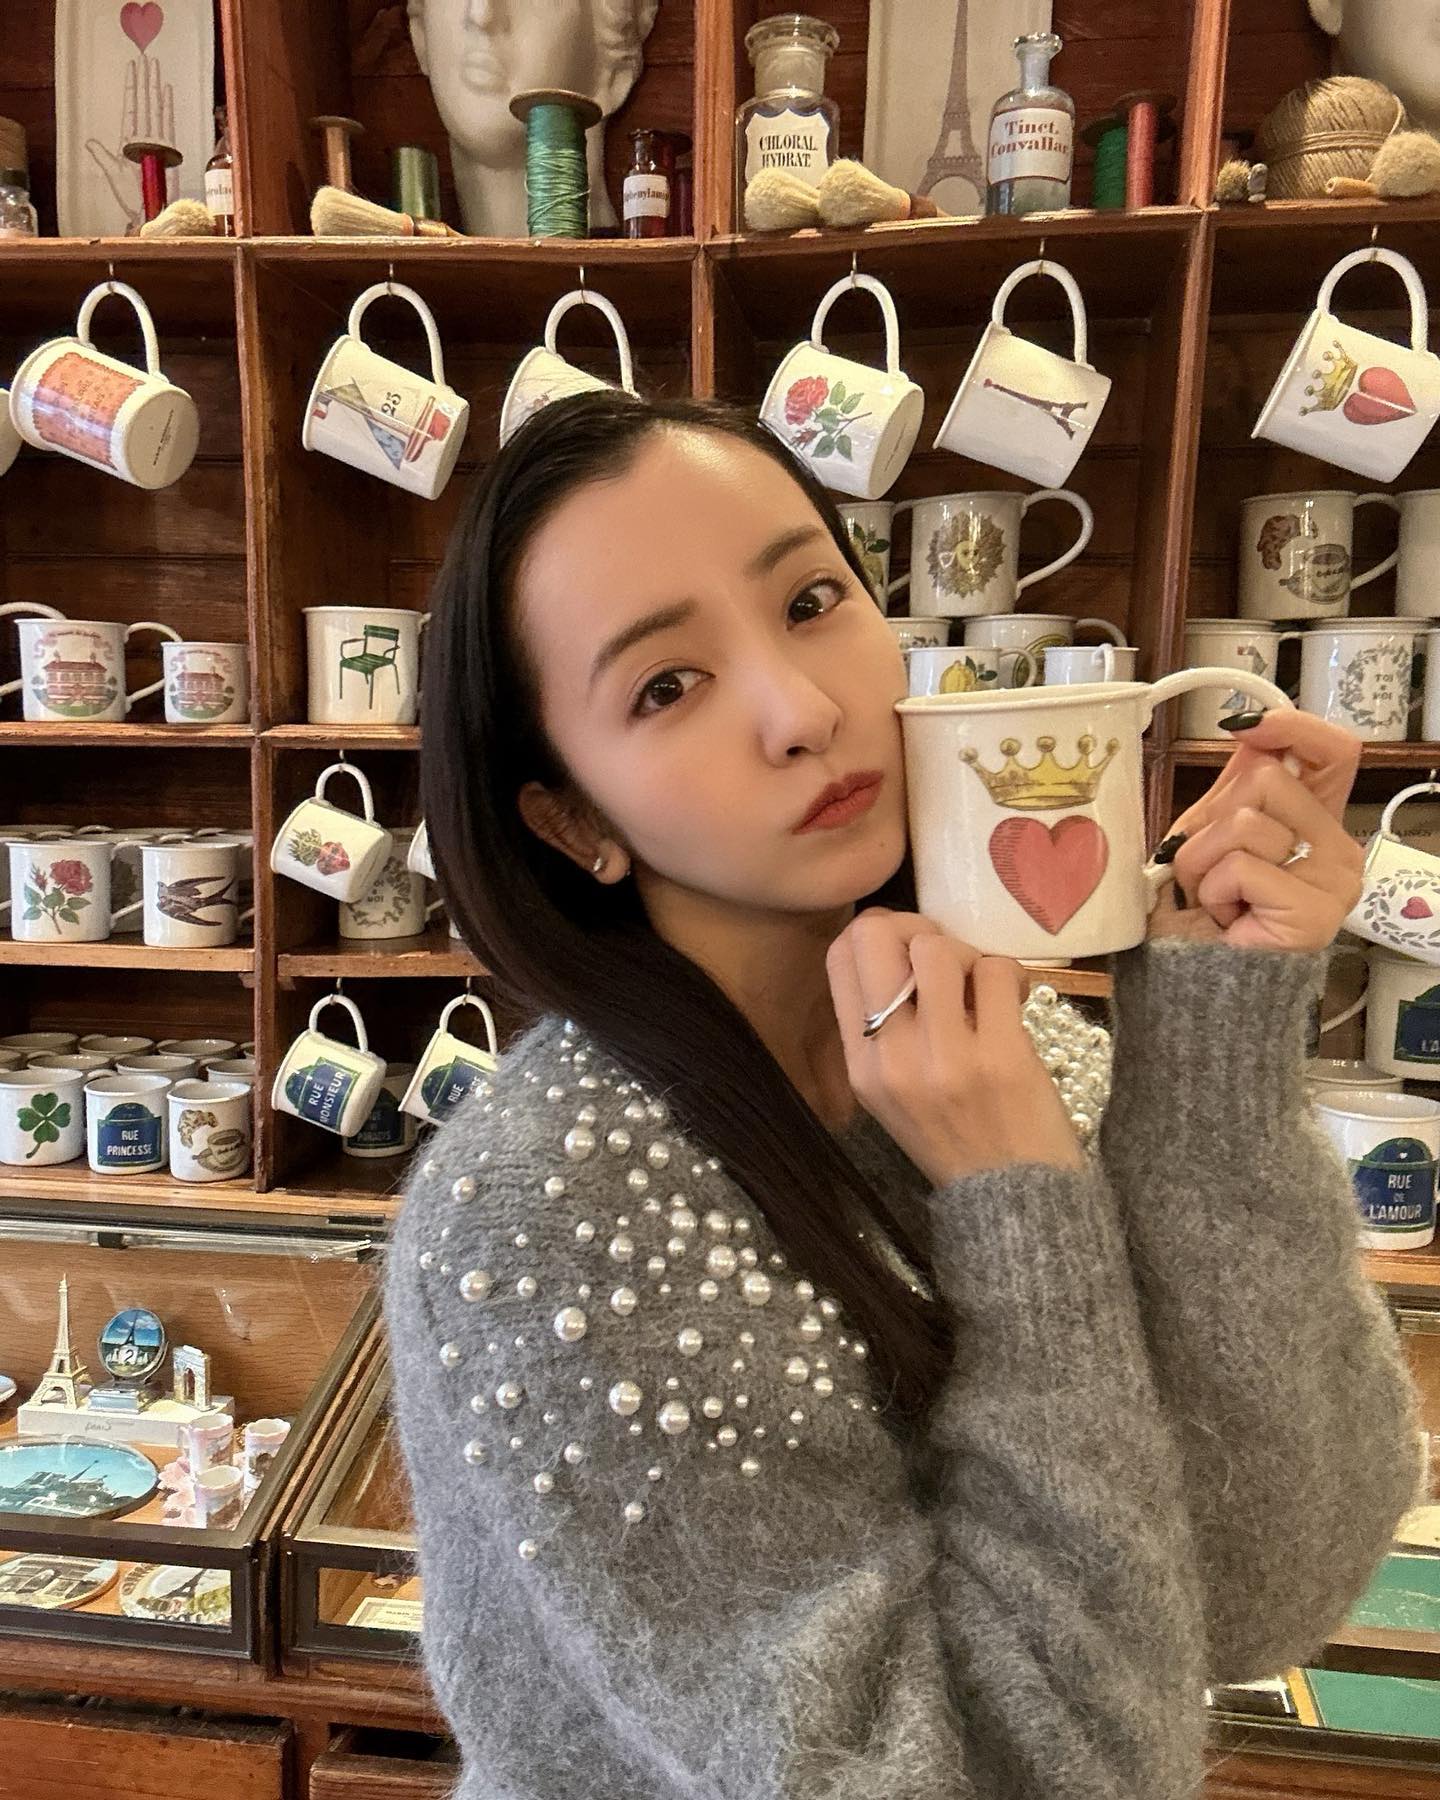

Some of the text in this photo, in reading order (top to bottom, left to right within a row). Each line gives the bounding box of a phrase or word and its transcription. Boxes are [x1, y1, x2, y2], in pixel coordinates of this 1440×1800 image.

[1004, 119, 1060, 136] Tinct.
[759, 134, 818, 152] CHLORAL
[380, 391, 402, 417] 25
[1375, 673, 1394, 683] TOI
[308, 1083, 325, 1106] RUE
[319, 1070, 347, 1124] MONSIEUR
[447, 1082, 465, 1103] RUE
[121, 1129, 139, 1141] RUE
[106, 1143, 153, 1157] PRINCESSE
[1387, 1174, 1413, 1190] RUE
[1368, 1203, 1423, 1221] L'AMOUR
